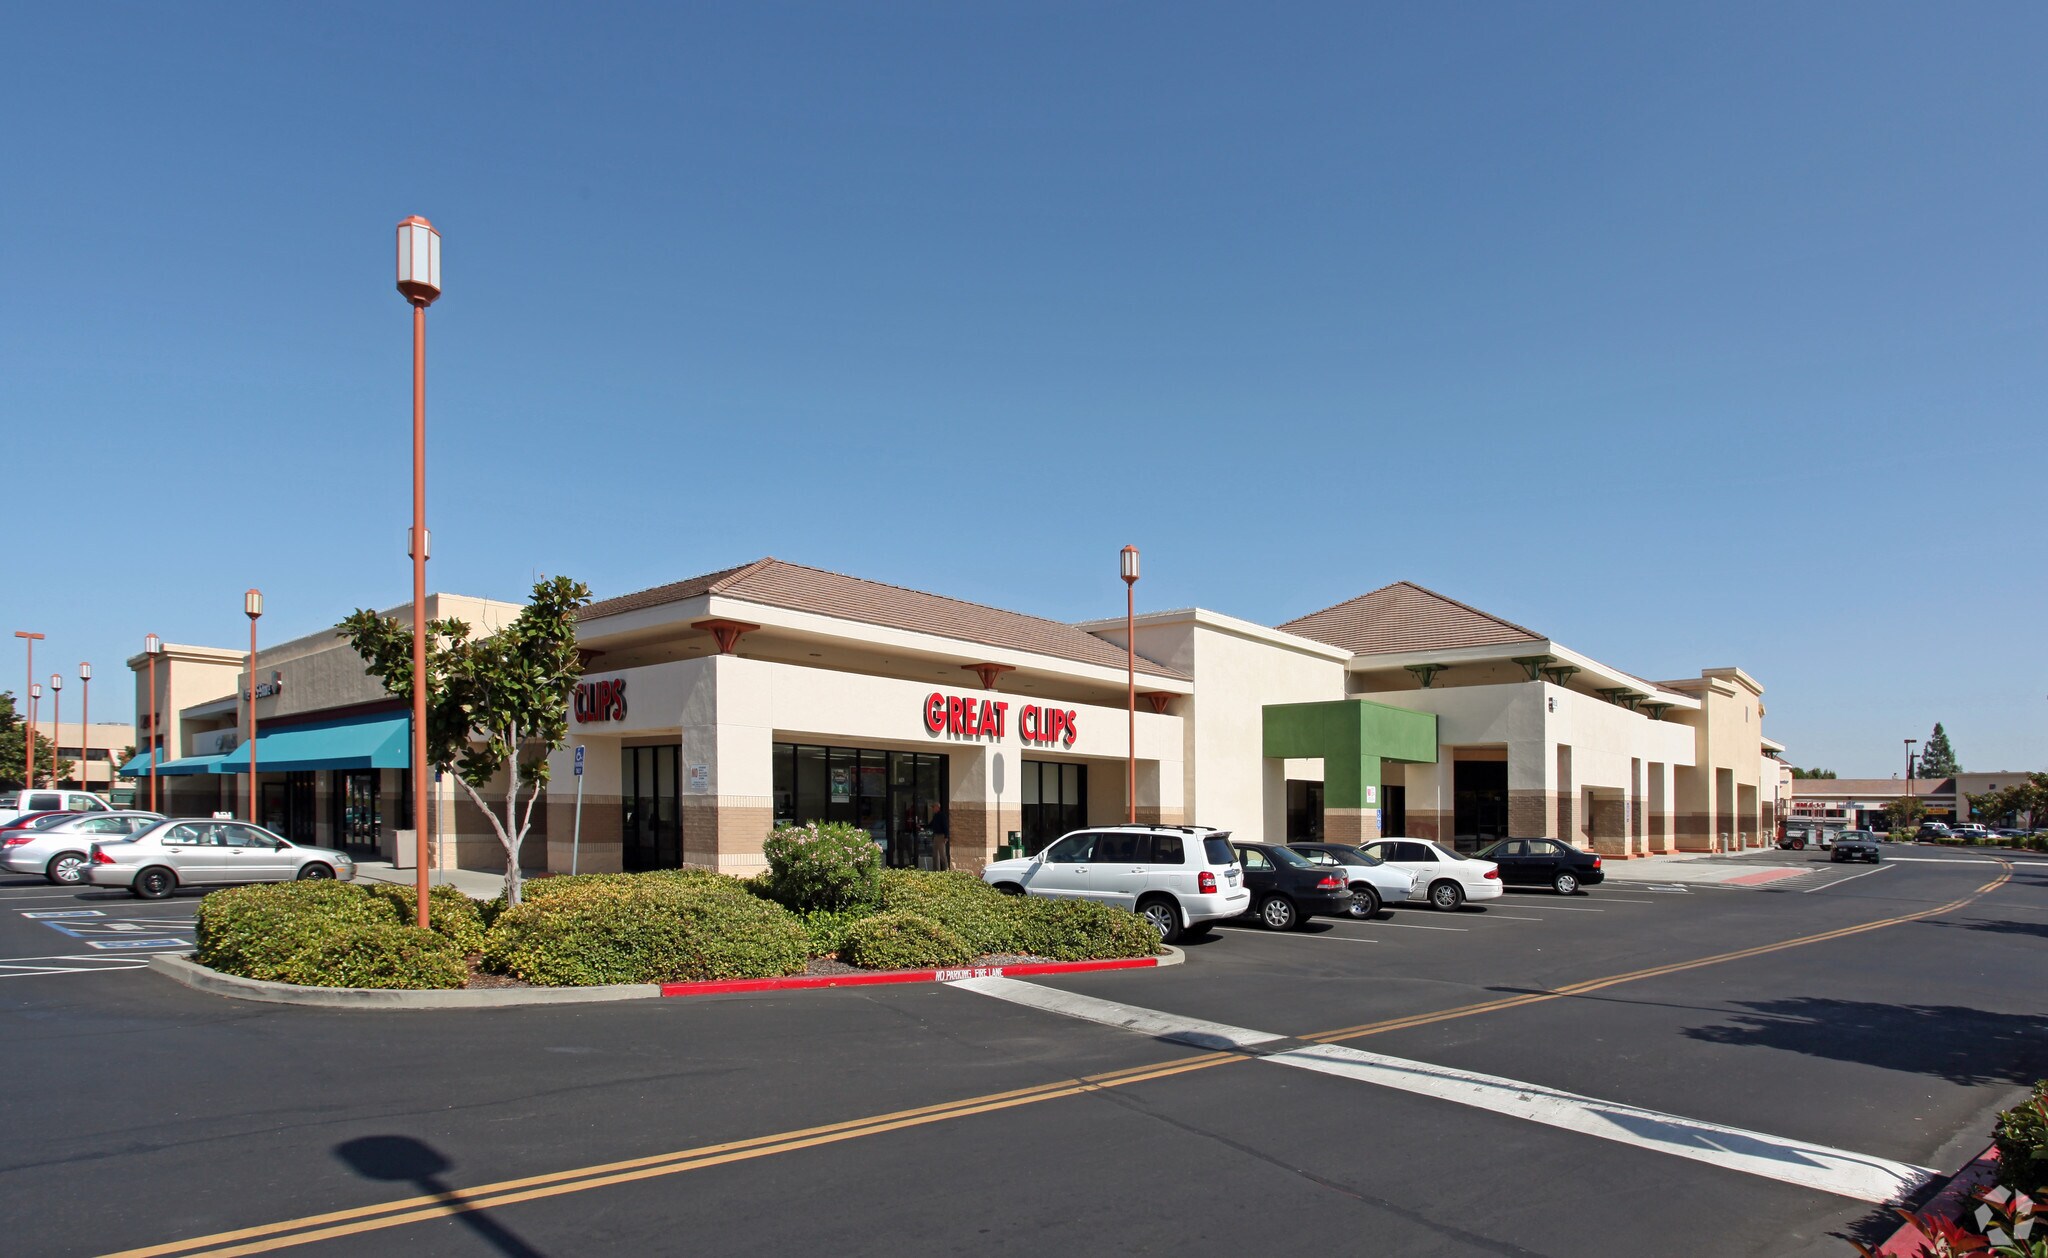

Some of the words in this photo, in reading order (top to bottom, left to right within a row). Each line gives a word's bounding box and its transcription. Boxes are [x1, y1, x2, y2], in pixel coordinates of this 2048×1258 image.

[574, 678, 627, 723] CLIPS
[925, 692, 1008, 738] GREAT
[1020, 704, 1077, 745] CLIPS
[935, 970, 945, 981] NO
[946, 969, 972, 980] PARKING
[974, 968, 987, 978] FIRE
[988, 967, 1004, 977] LANE
